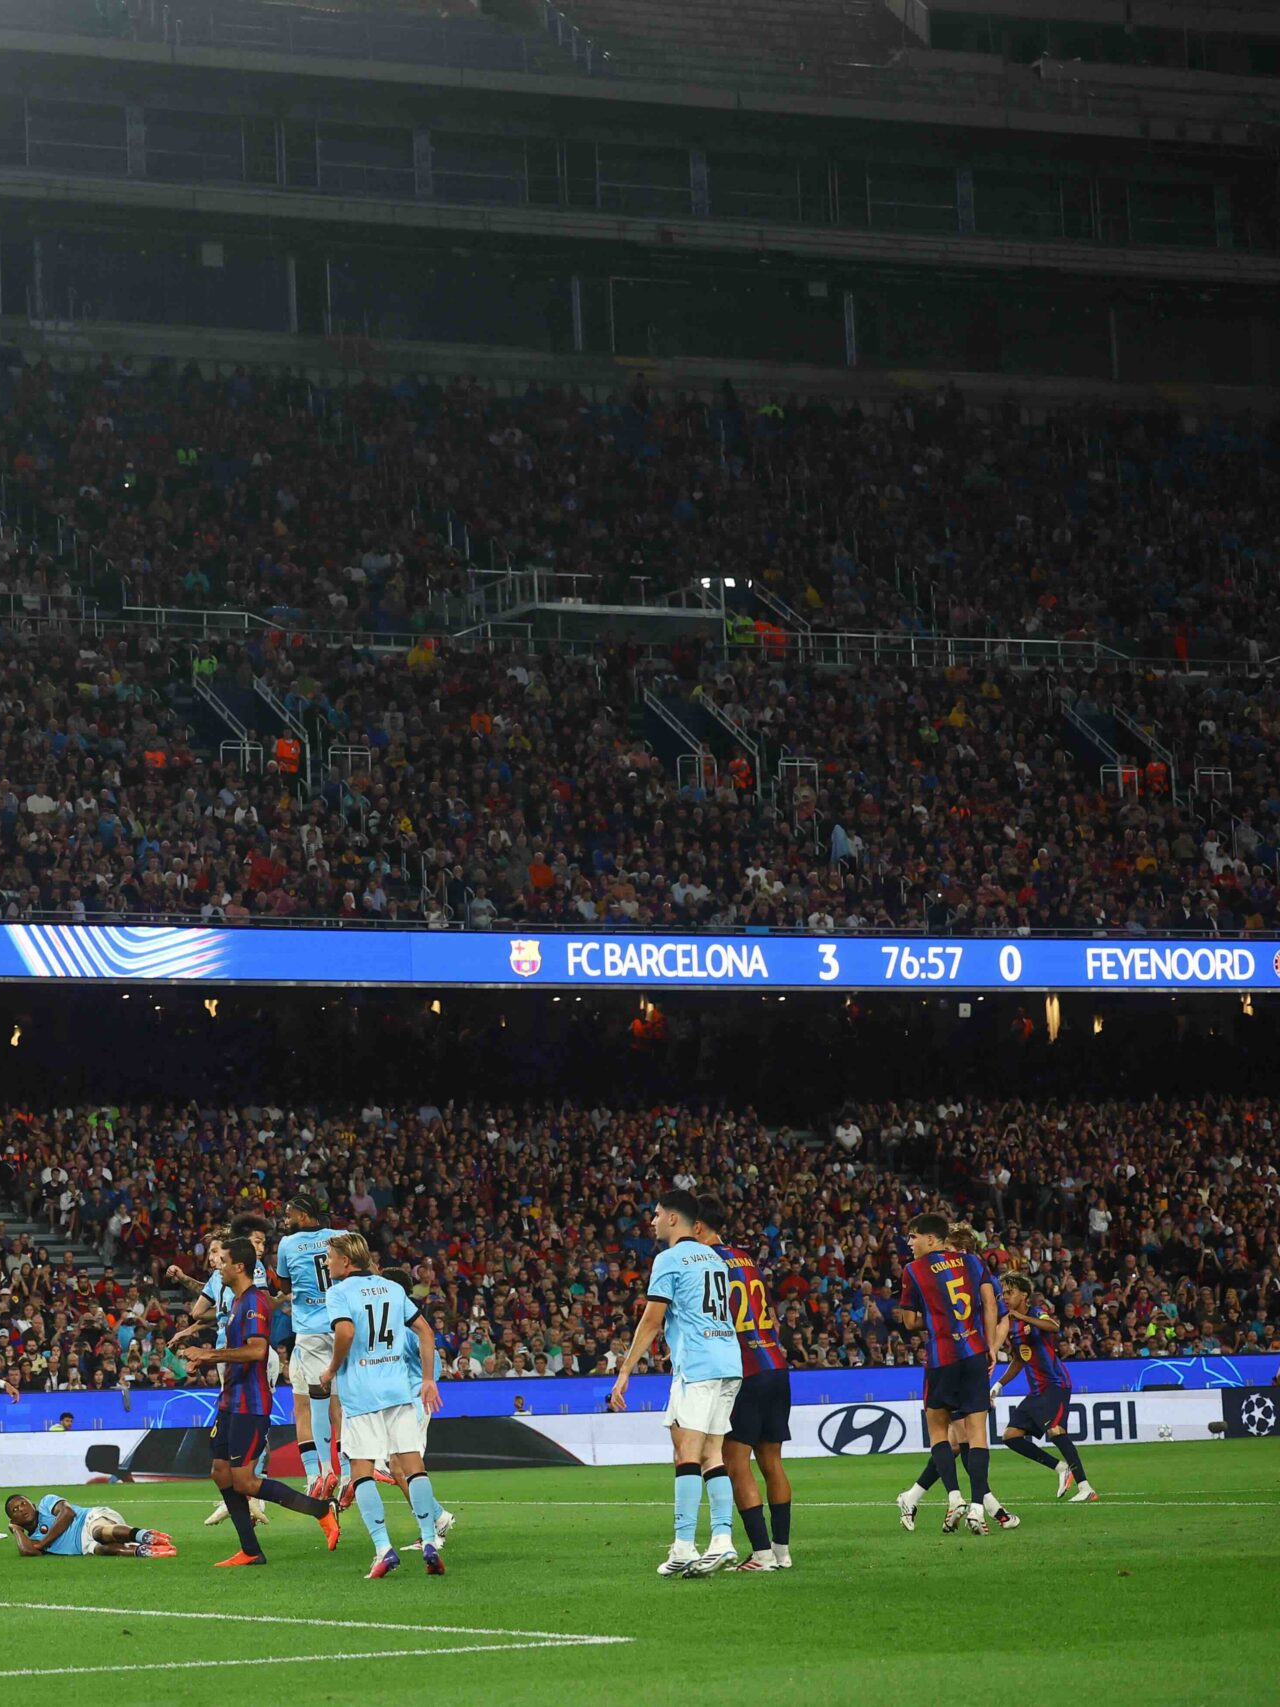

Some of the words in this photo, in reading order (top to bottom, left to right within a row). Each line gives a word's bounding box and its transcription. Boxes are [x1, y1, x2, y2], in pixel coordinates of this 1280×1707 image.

[567, 941, 602, 977] FC
[604, 942, 769, 978] BARCELONA
[817, 943, 840, 981] 3
[881, 946, 963, 980] 76:57
[999, 944, 1022, 982] 0
[1086, 947, 1256, 981] FEYENOORD
[702, 1270, 728, 1322] 49
[729, 1279, 774, 1332] 22
[945, 1276, 972, 1321] 5
[364, 1301, 394, 1352] 14
